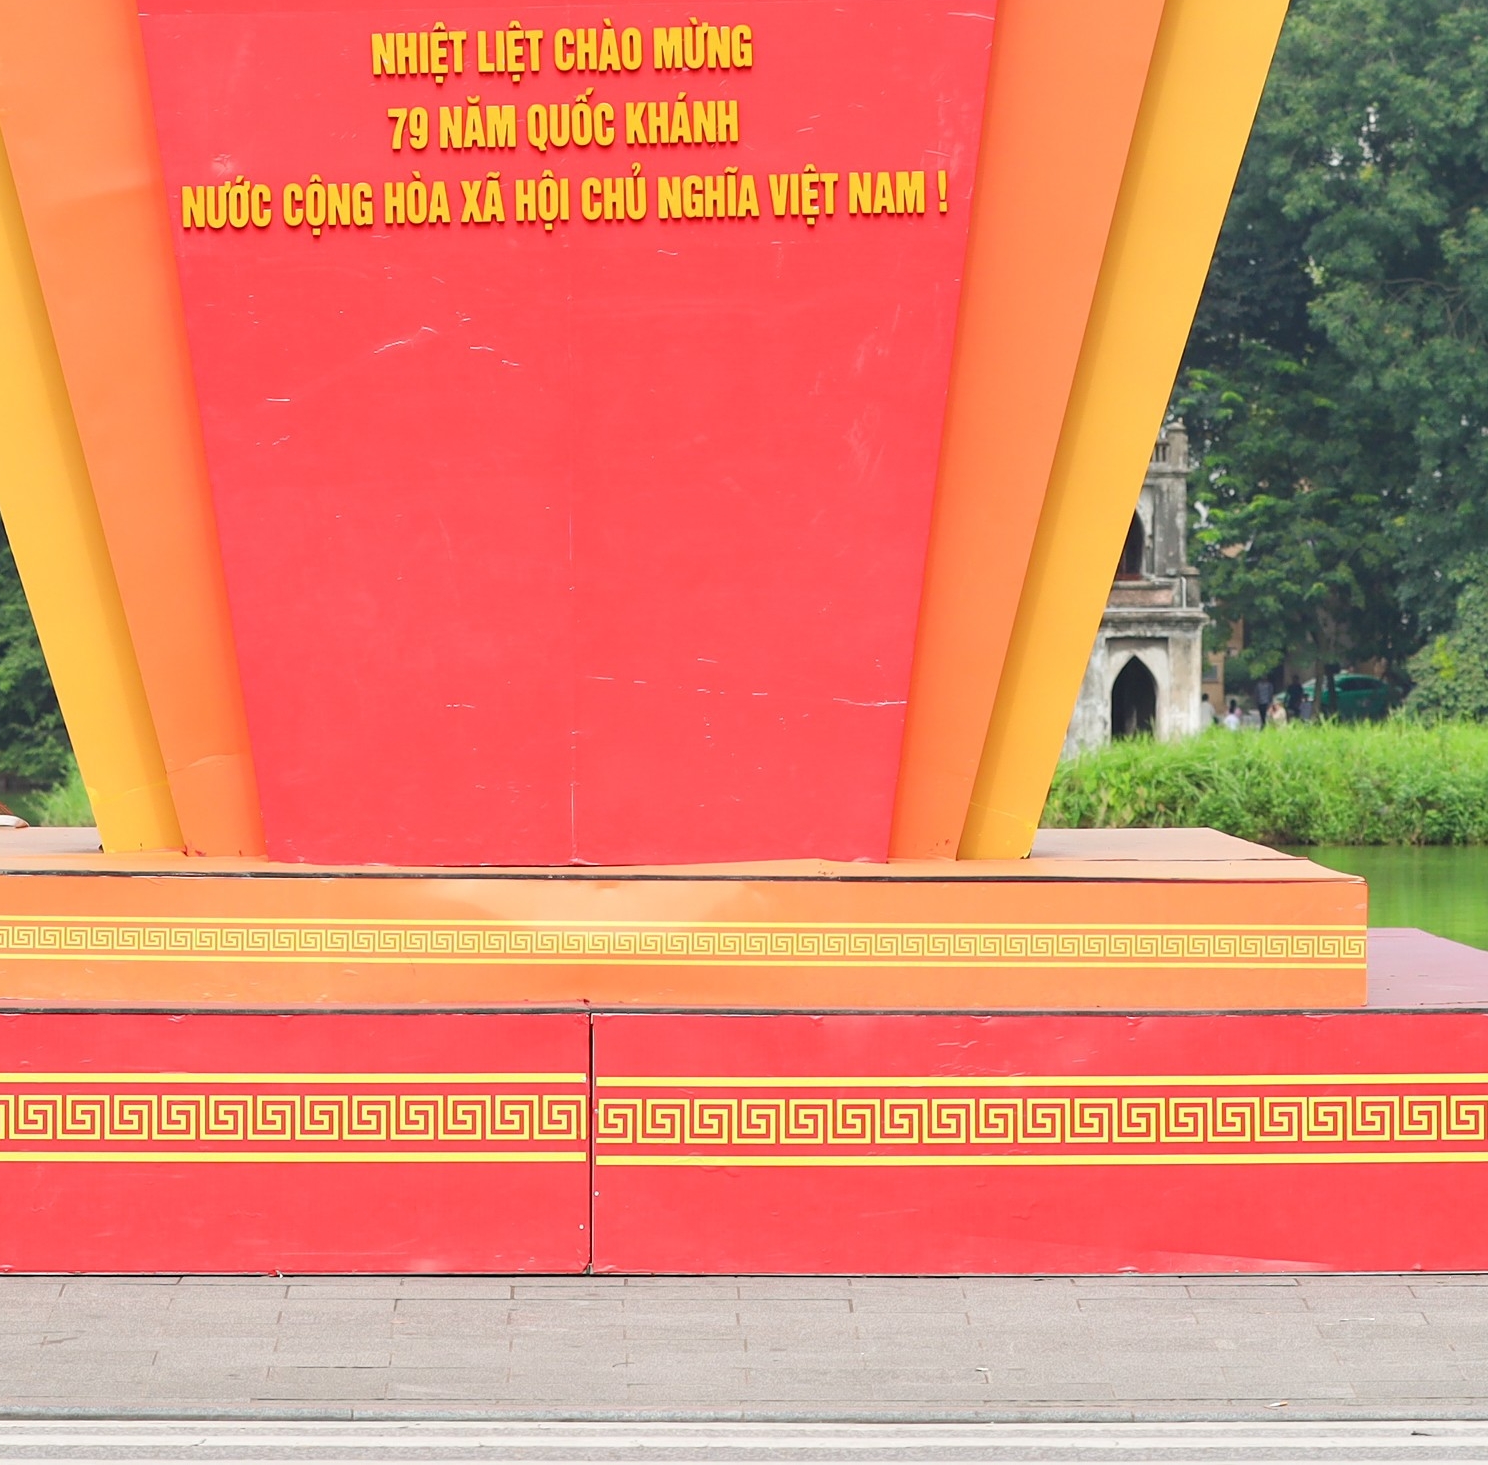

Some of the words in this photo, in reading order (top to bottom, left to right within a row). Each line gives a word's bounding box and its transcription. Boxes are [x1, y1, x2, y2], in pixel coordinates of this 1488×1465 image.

[371, 21, 466, 83] NHIỆT
[477, 20, 544, 82] LIỆT
[554, 18, 643, 72] CHÀO
[653, 16, 753, 70] MỪNG
[387, 106, 429, 150] 79
[439, 96, 517, 149] NĂM
[527, 87, 615, 151] QUỐC
[625, 92, 739, 145] KHÁNH
[181, 175, 272, 229] NƯỚC
[283, 174, 374, 236] CỘNG
[384, 171, 451, 225] HÒA
[461, 171, 506, 224] XÃ
[515, 169, 570, 232] HỘI
[581, 162, 647, 221] CHỦ
[657, 166, 760, 219] NGHĨA
[768, 163, 839, 225] VIỆT
[848, 170, 925, 215] NAM
[937, 170, 948, 212] !
